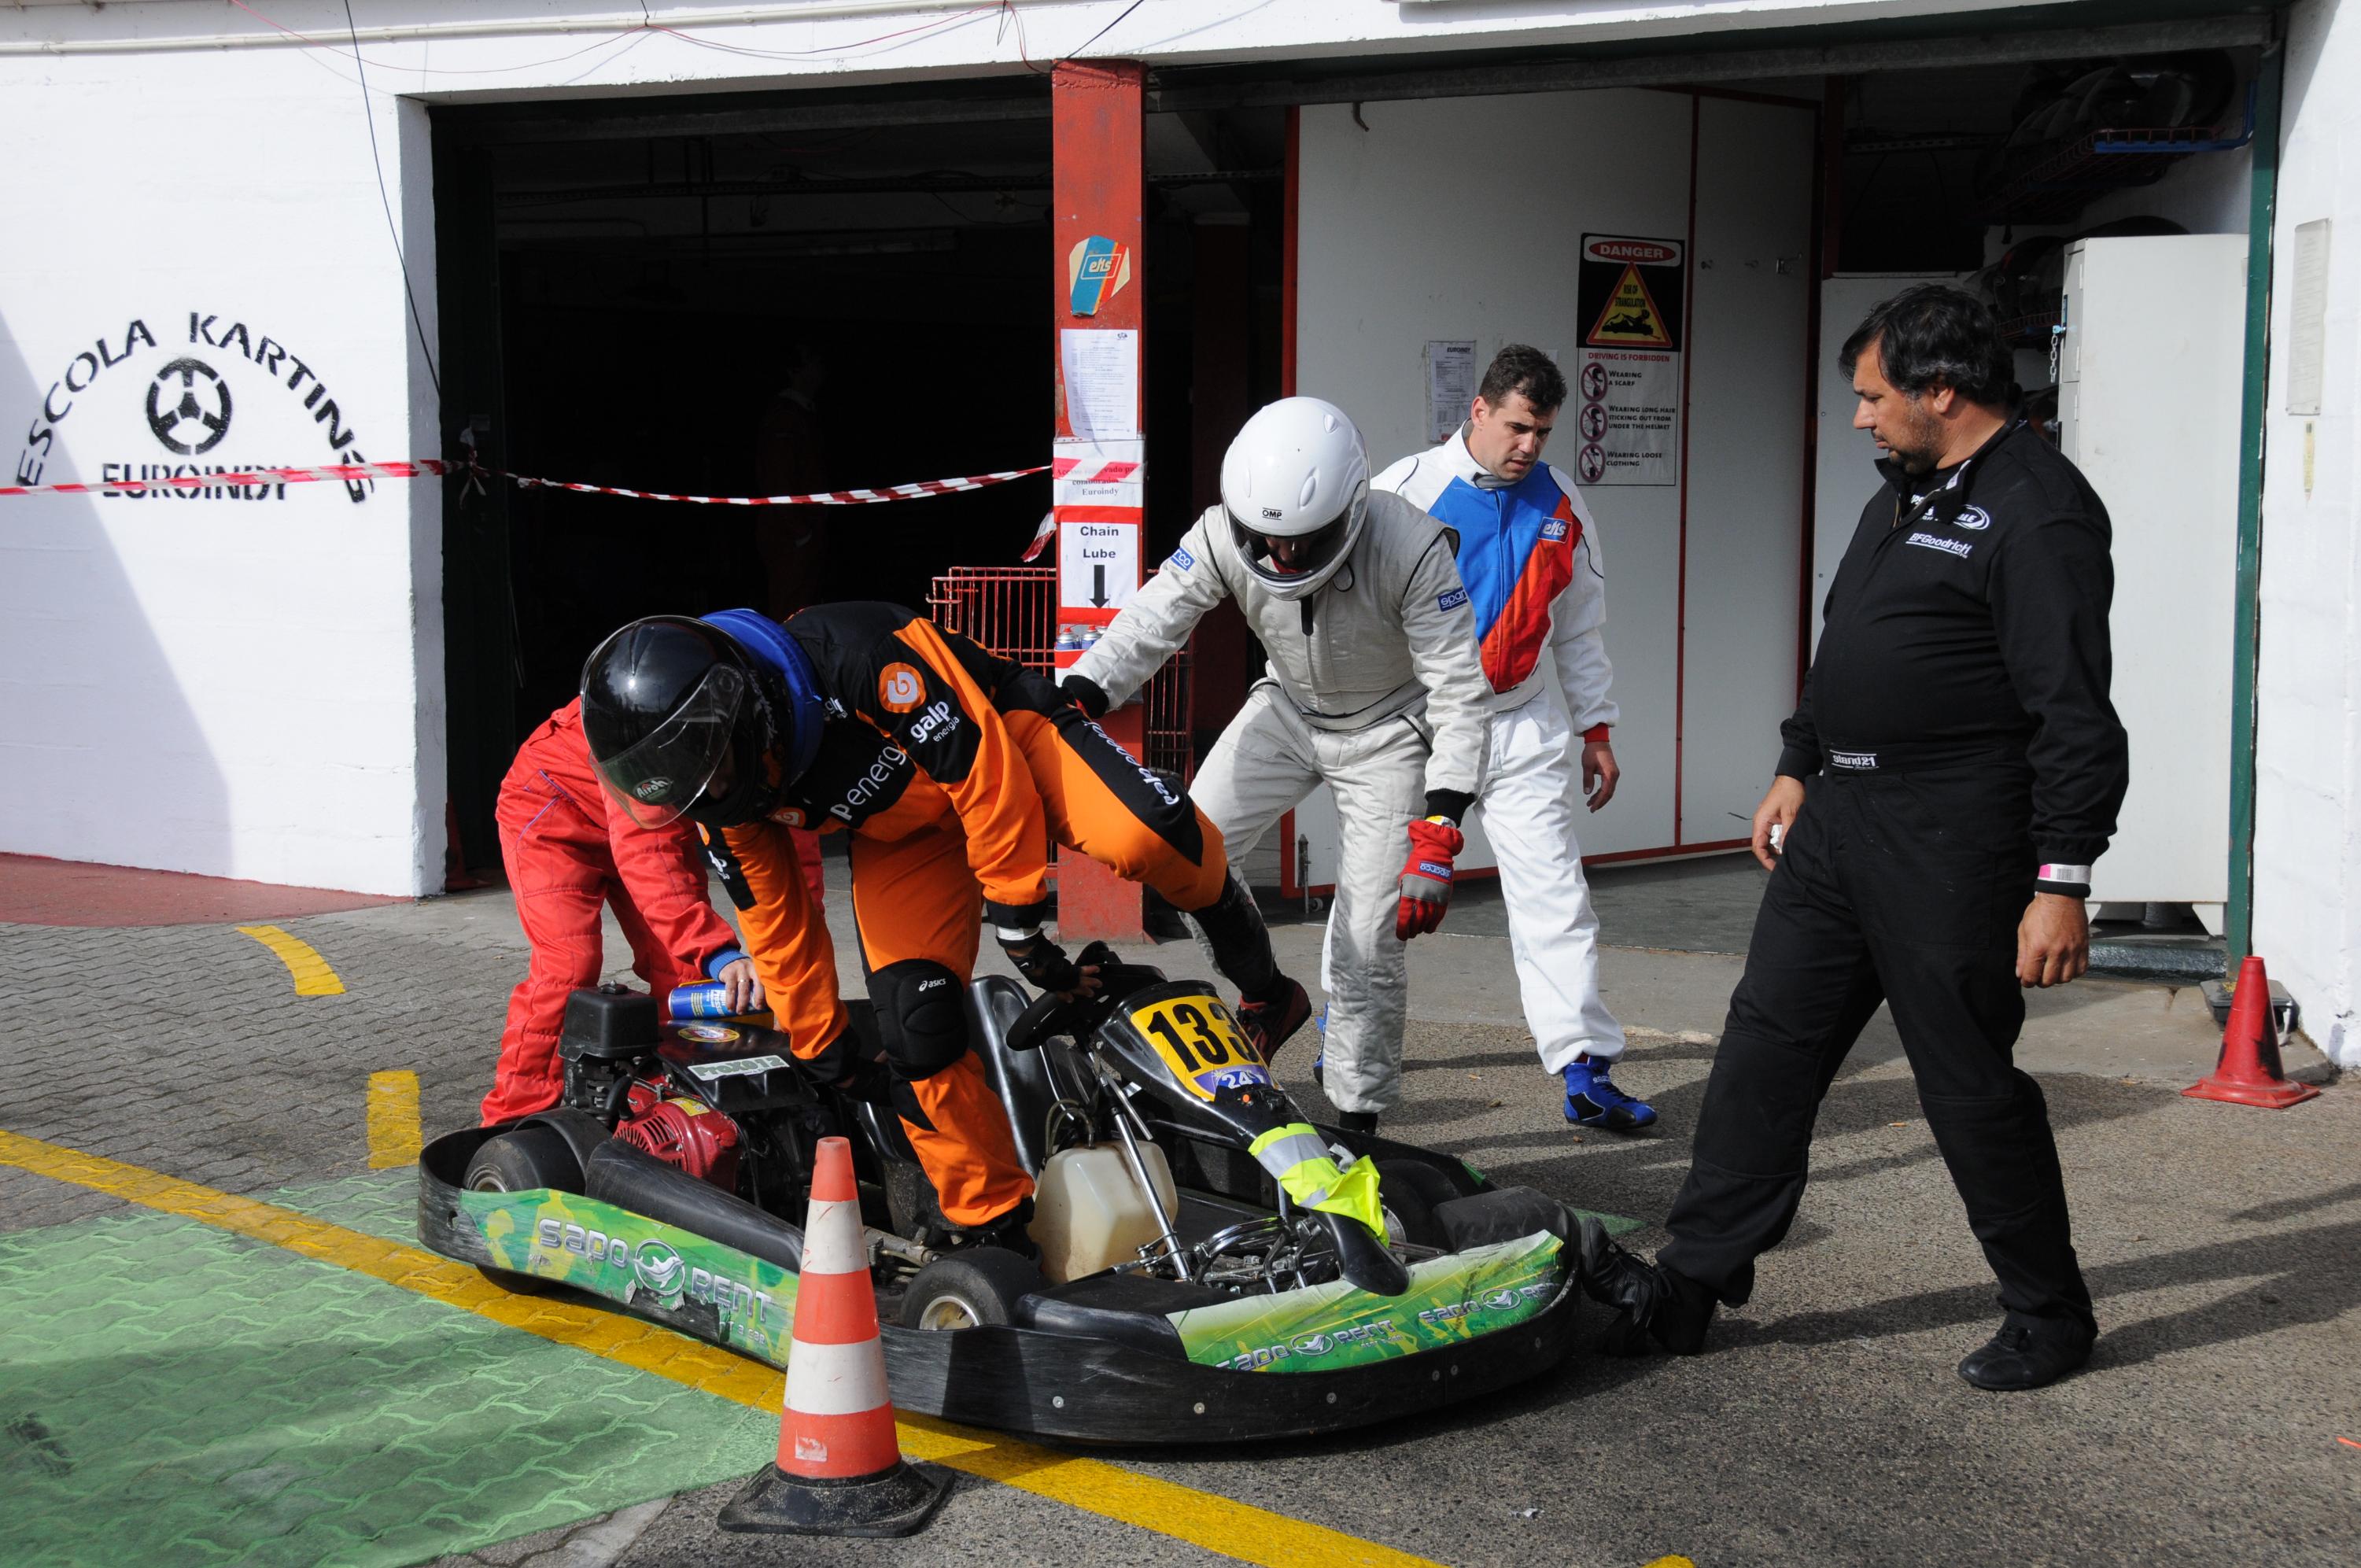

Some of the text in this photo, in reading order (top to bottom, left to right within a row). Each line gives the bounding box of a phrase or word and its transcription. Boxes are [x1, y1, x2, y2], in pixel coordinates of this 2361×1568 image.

[1599, 245, 1664, 259] DANGER
[1588, 352, 1619, 360] DRIVING
[1629, 354, 1670, 363] FORBIDDEN
[16, 319, 157, 487] ESCOLA
[1082, 488, 1119, 496] Euroindy
[1262, 509, 1282, 519] OMP
[1080, 526, 1120, 537] Chain
[1083, 548, 1116, 559] Lube
[1441, 591, 1469, 609] spar
[910, 701, 950, 743] galp
[932, 716, 960, 743] energia
[847, 746, 906, 806] energ
[636, 780, 669, 799] Airoh
[928, 978, 946, 989] asics
